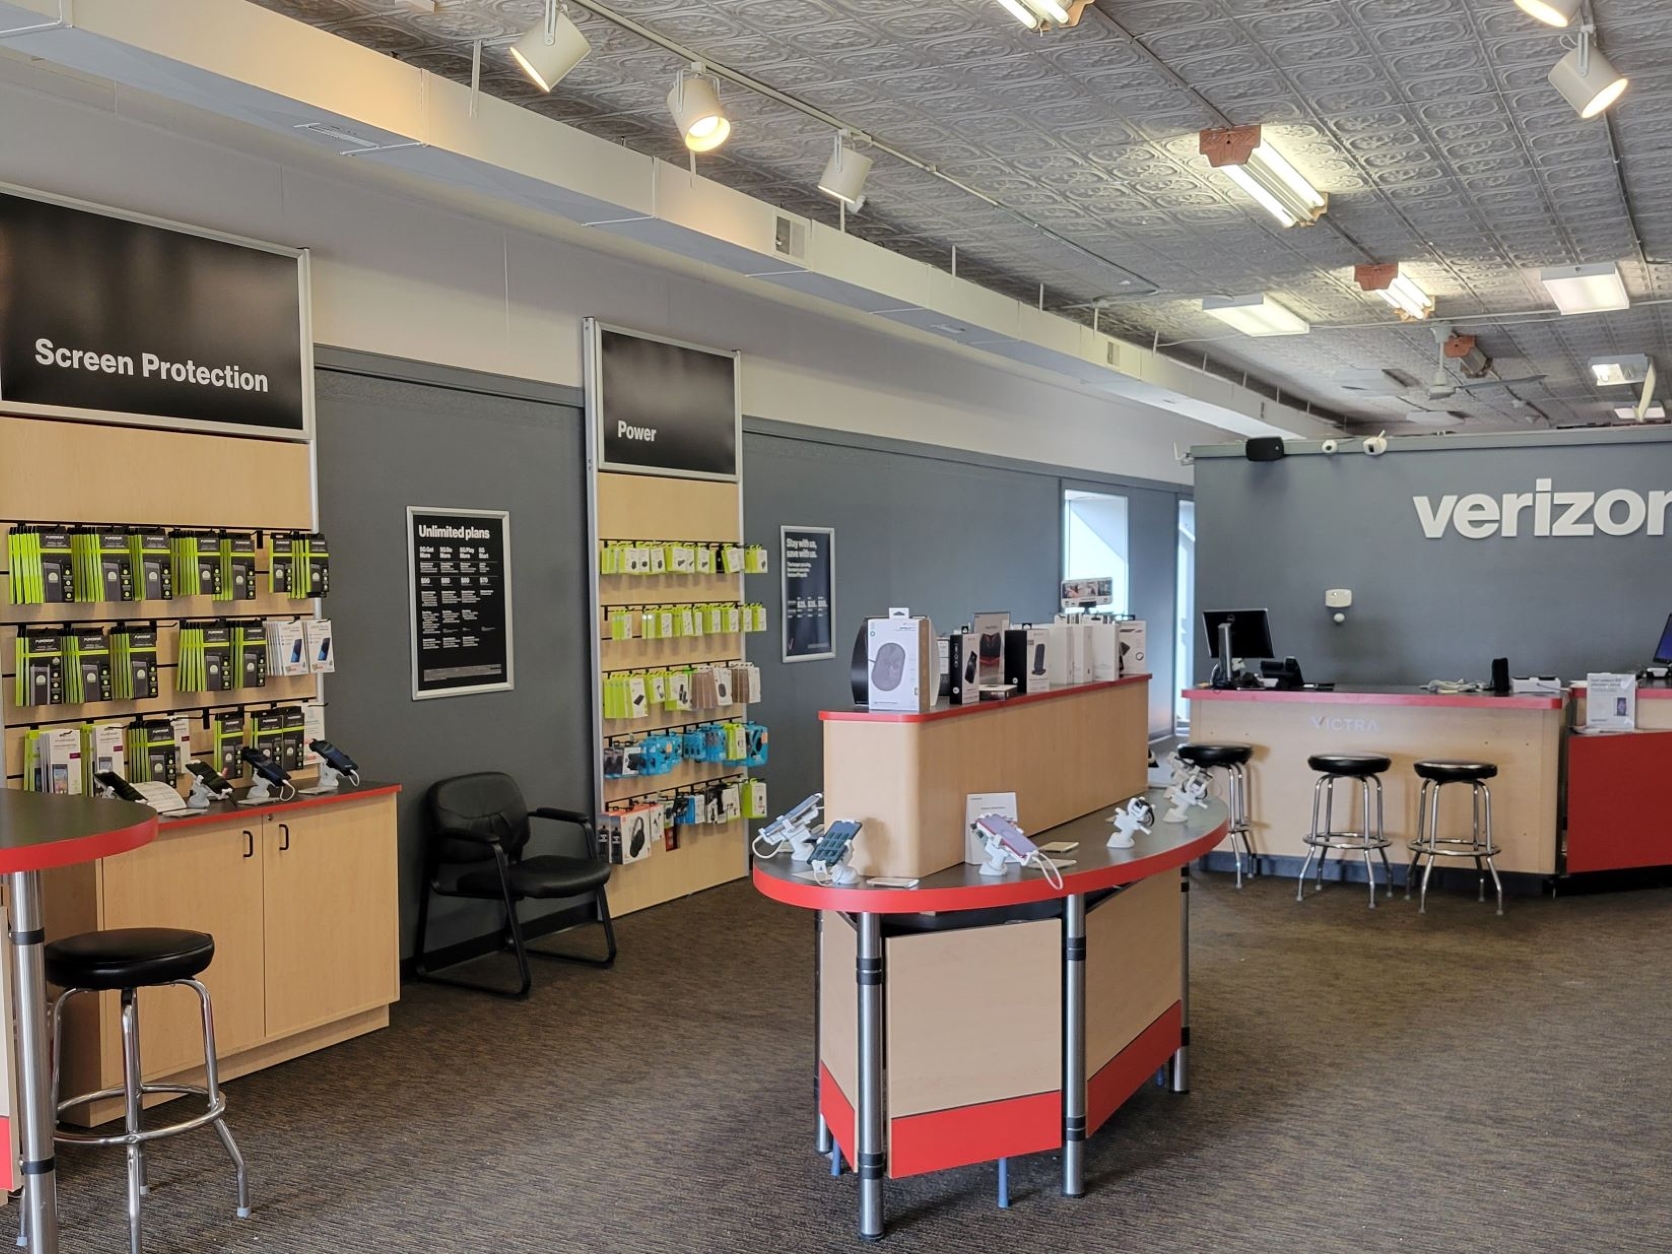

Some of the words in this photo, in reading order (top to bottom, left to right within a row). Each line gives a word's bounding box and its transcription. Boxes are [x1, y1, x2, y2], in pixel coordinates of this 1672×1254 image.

[35, 338, 134, 376] Screen
[142, 352, 269, 393] Protection
[618, 420, 657, 442] Power
[418, 524, 464, 539] Unlimited
[465, 526, 490, 541] plans
[1310, 716, 1379, 732] VICTRA
